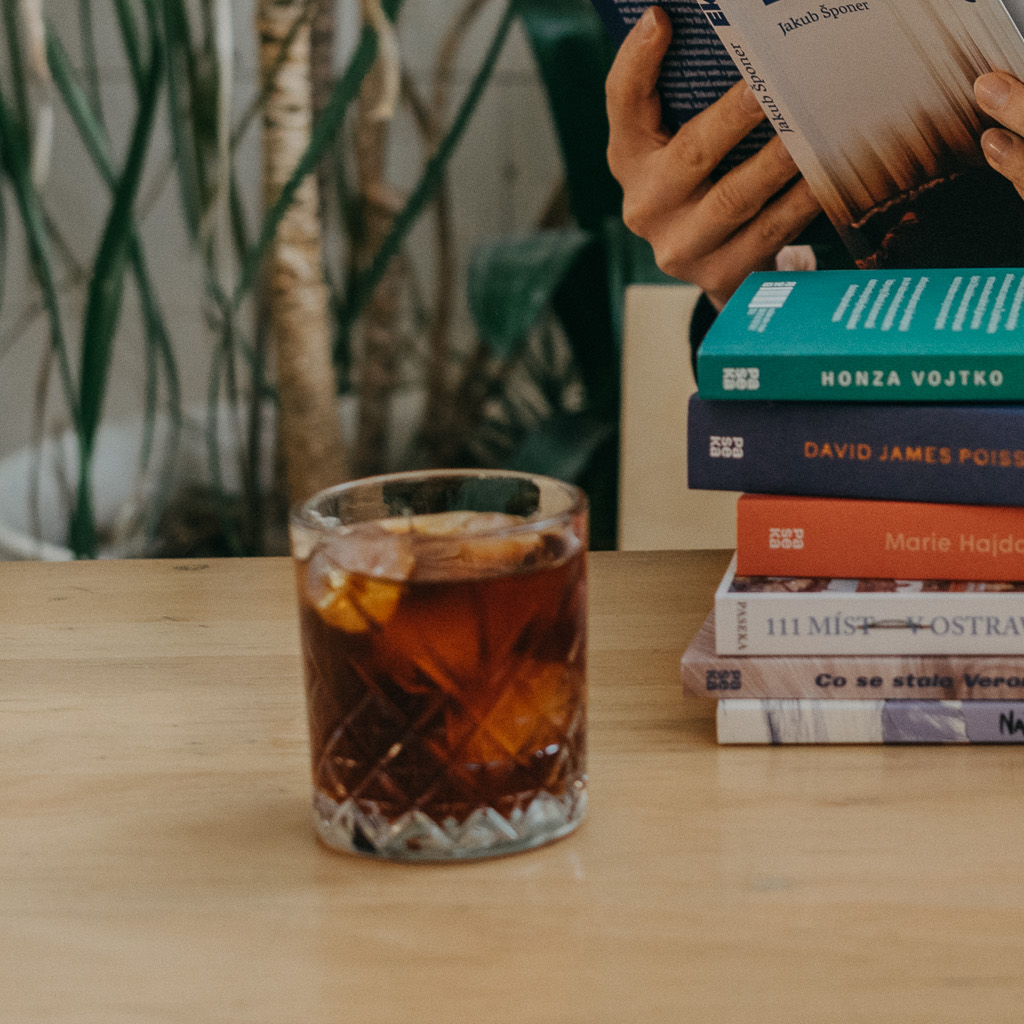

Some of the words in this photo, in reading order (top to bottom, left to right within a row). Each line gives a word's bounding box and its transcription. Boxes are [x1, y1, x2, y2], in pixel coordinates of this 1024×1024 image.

[777, 10, 820, 36] Jakub
[818, 0, 871, 21] Šponer
[730, 42, 769, 93] Šponer
[762, 95, 796, 134] Jakub
[820, 370, 902, 387] HONZA
[911, 369, 1004, 387] VOJTKO
[803, 440, 873, 462] DAVID
[879, 445, 952, 465] JAMES
[884, 532, 951, 554] Marie
[736, 601, 748, 651] PASEKA
[766, 617, 800, 636] 111
[808, 611, 876, 636] MÍST
[815, 673, 847, 688] Co
[856, 674, 883, 688] se
